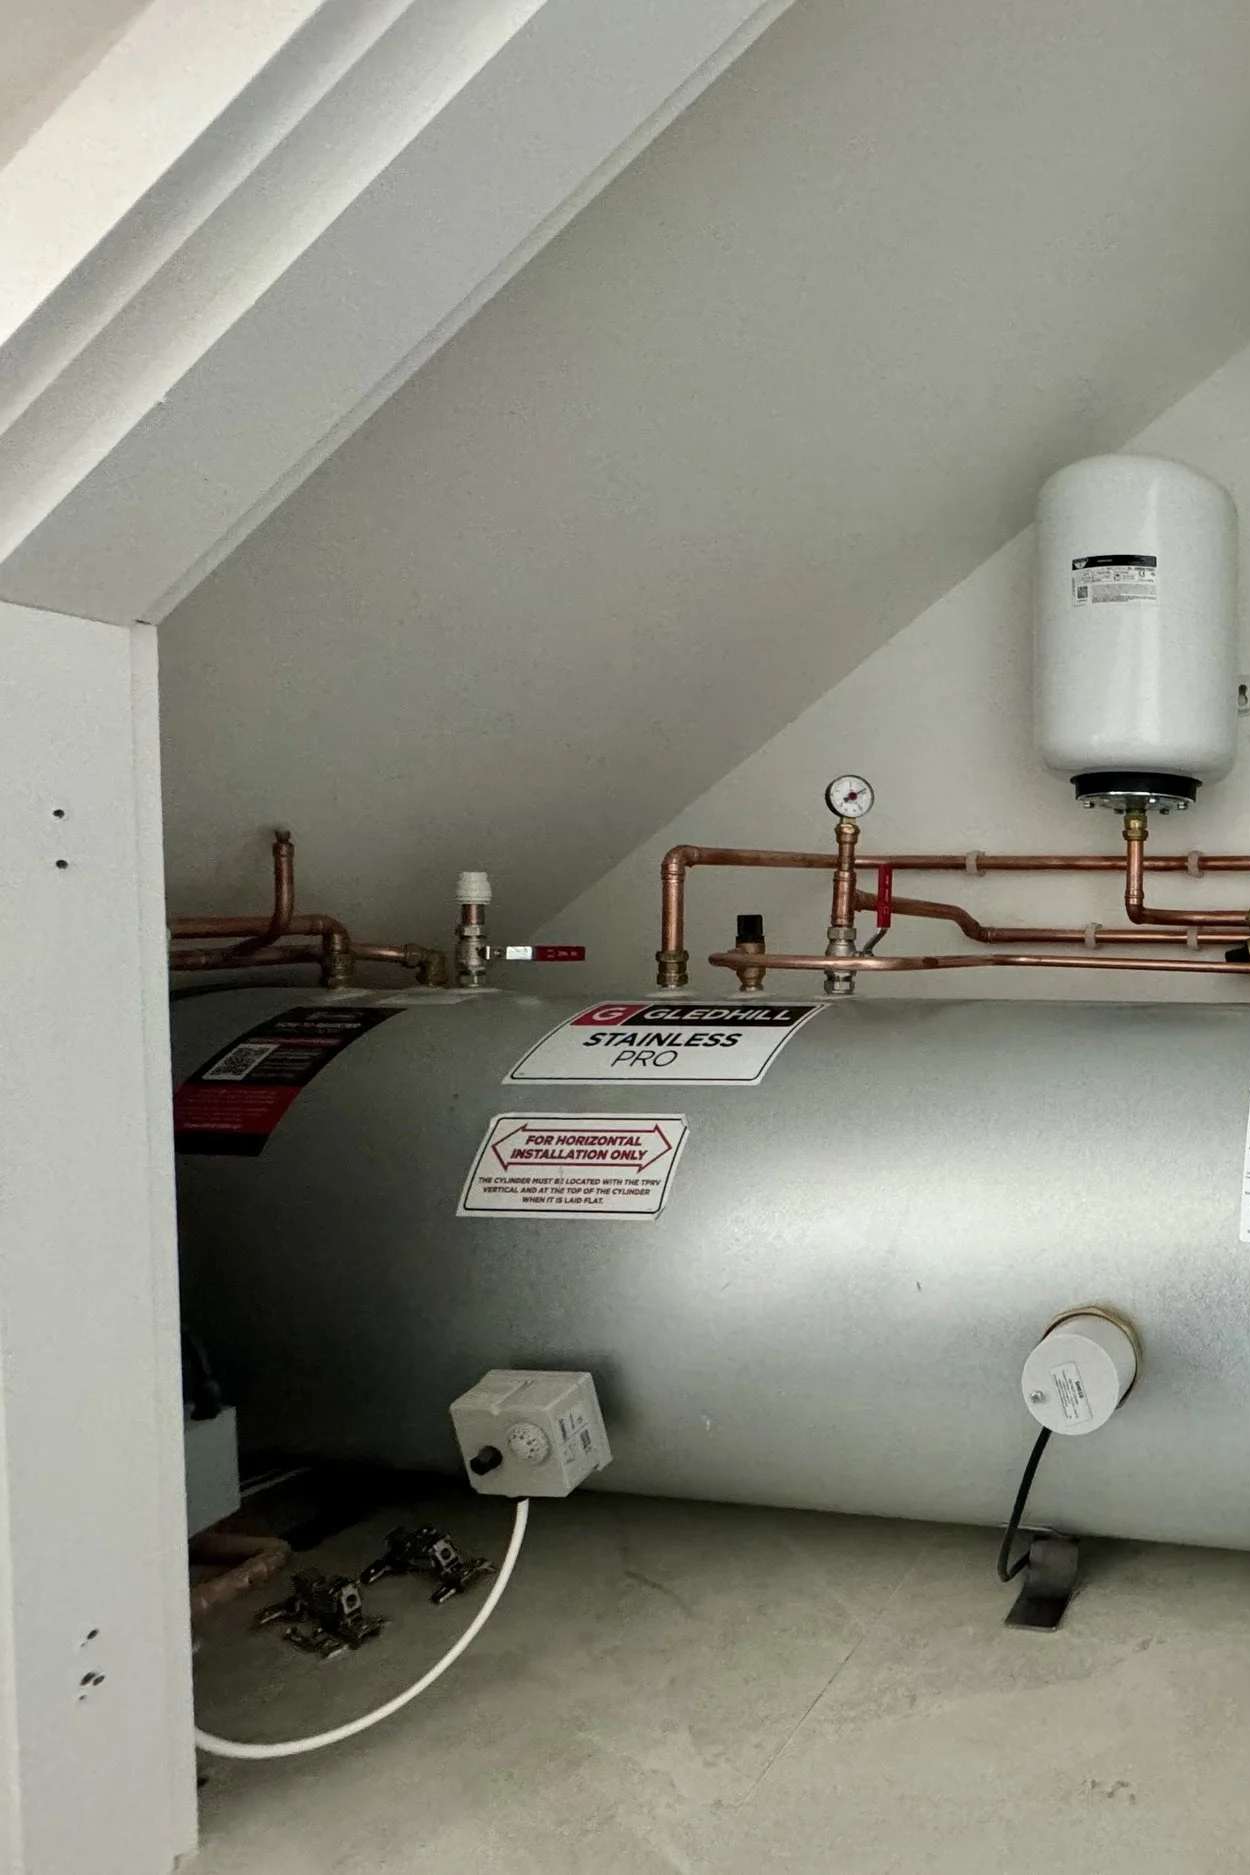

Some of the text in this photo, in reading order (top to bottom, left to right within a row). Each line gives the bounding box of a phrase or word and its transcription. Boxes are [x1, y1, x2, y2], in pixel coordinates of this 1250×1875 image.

[643, 1008, 793, 1021] GLEDHILL
[583, 1032, 743, 1047] STAINLESS
[611, 1050, 679, 1067] PRO
[525, 1135, 642, 1147] FOR HORIZONTAL
[510, 1149, 648, 1161] INSTALLATION ONLY
[602, 1178, 624, 1186] WITH
[567, 1187, 582, 1195] TOP
[612, 1188, 650, 1196] CYLINDER
